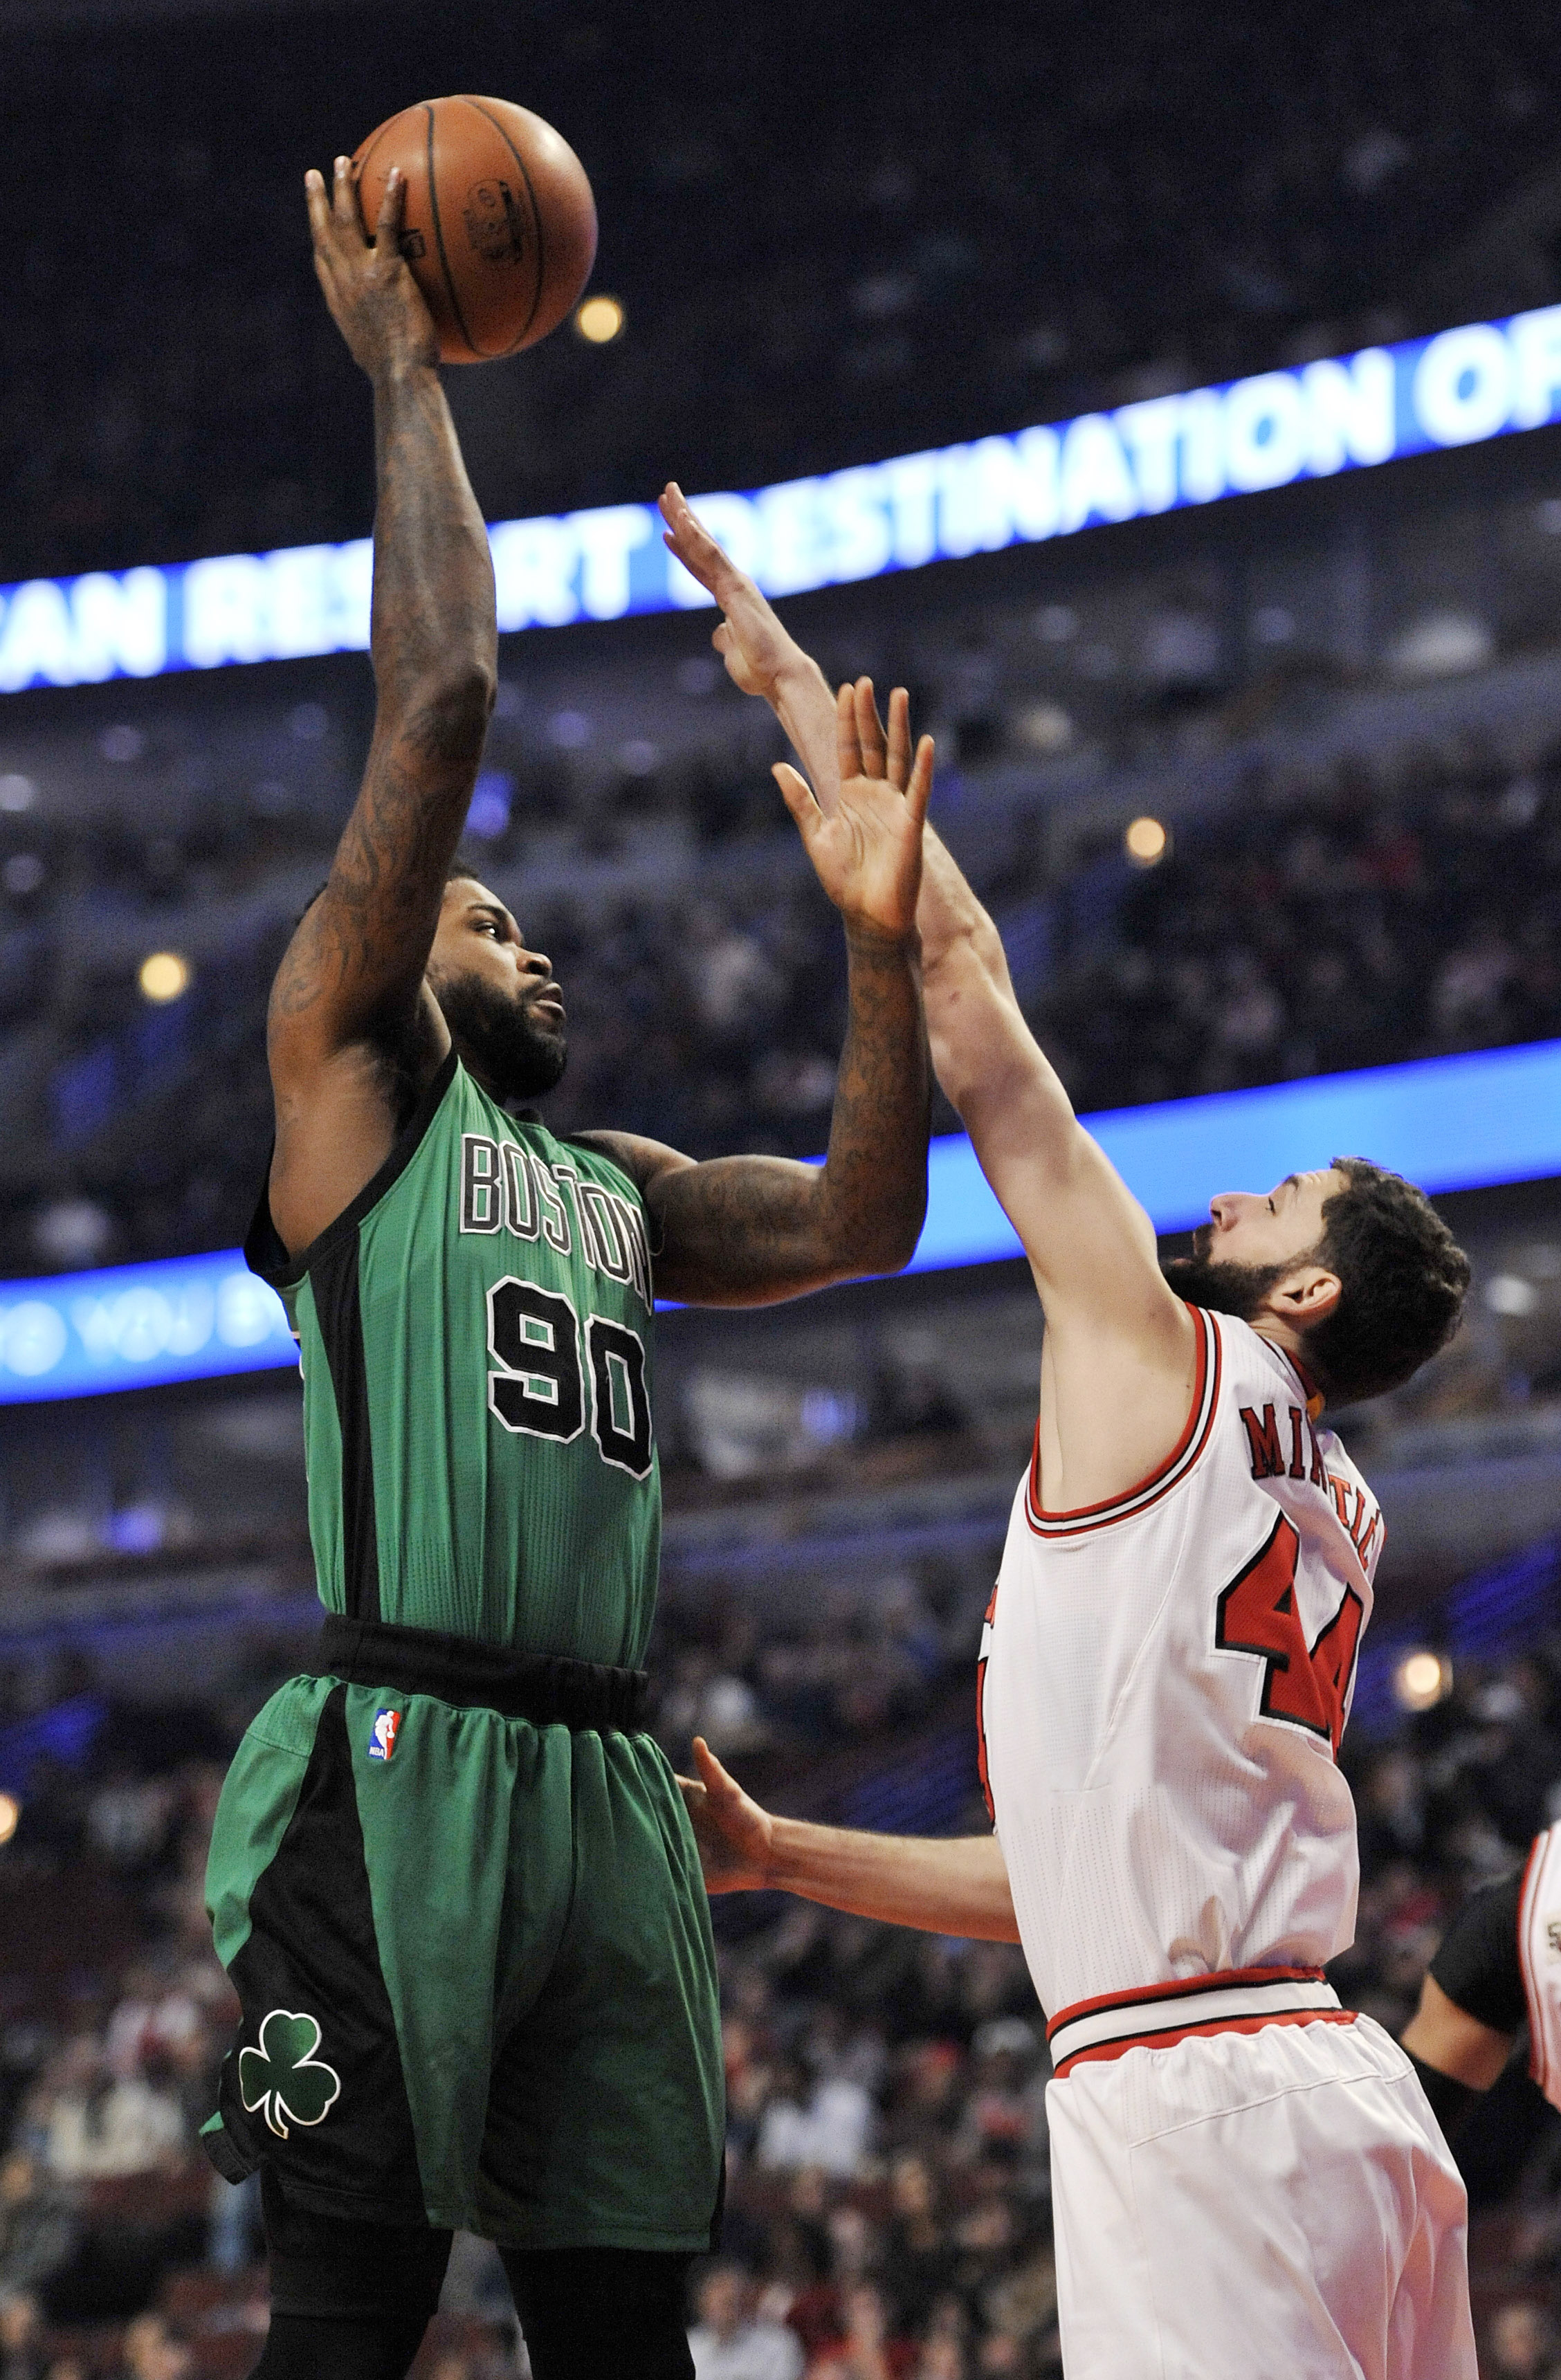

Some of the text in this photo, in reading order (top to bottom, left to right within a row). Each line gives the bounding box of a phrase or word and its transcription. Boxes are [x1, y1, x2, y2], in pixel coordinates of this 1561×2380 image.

[0, 579, 167, 693] AN
[183, 504, 652, 670] RERT
[667, 347, 1395, 610] DESTINATION
[460, 1133, 651, 1316] BOSTON
[486, 1275, 653, 1481] 90
[1214, 1507, 1364, 1765] 44
[369, 1746, 384, 1757] NBA
